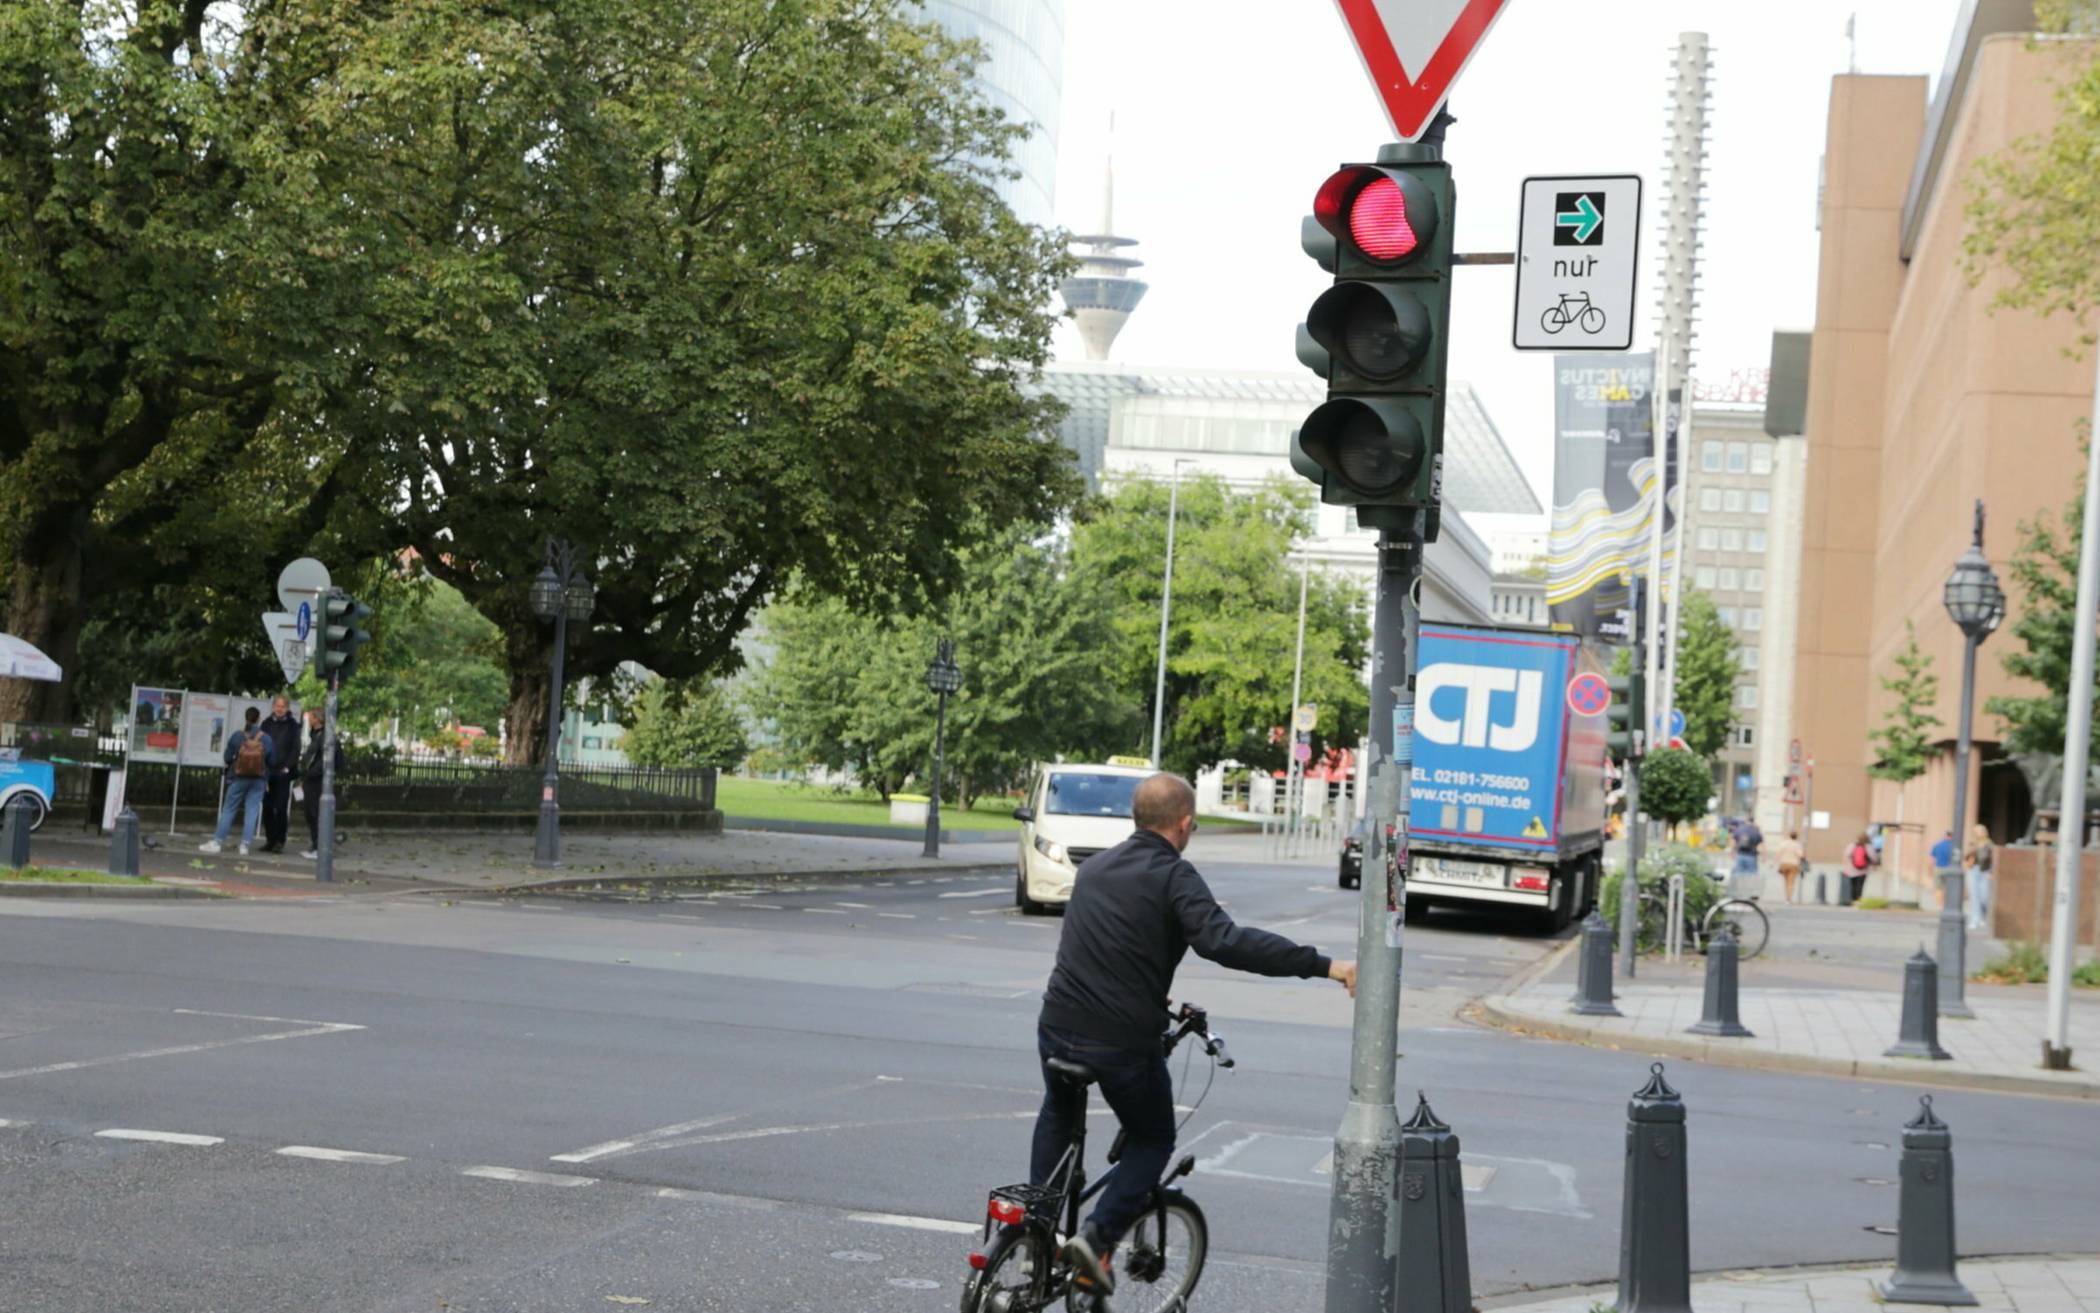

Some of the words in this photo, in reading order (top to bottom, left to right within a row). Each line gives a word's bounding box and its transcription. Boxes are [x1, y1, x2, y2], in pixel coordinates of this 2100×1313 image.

[1554, 260, 1598, 277] nur
[1413, 662, 1543, 752] CTJ
[1411, 767, 1431, 781] EL.
[1410, 787, 1532, 810] ww.ctj-online.de
